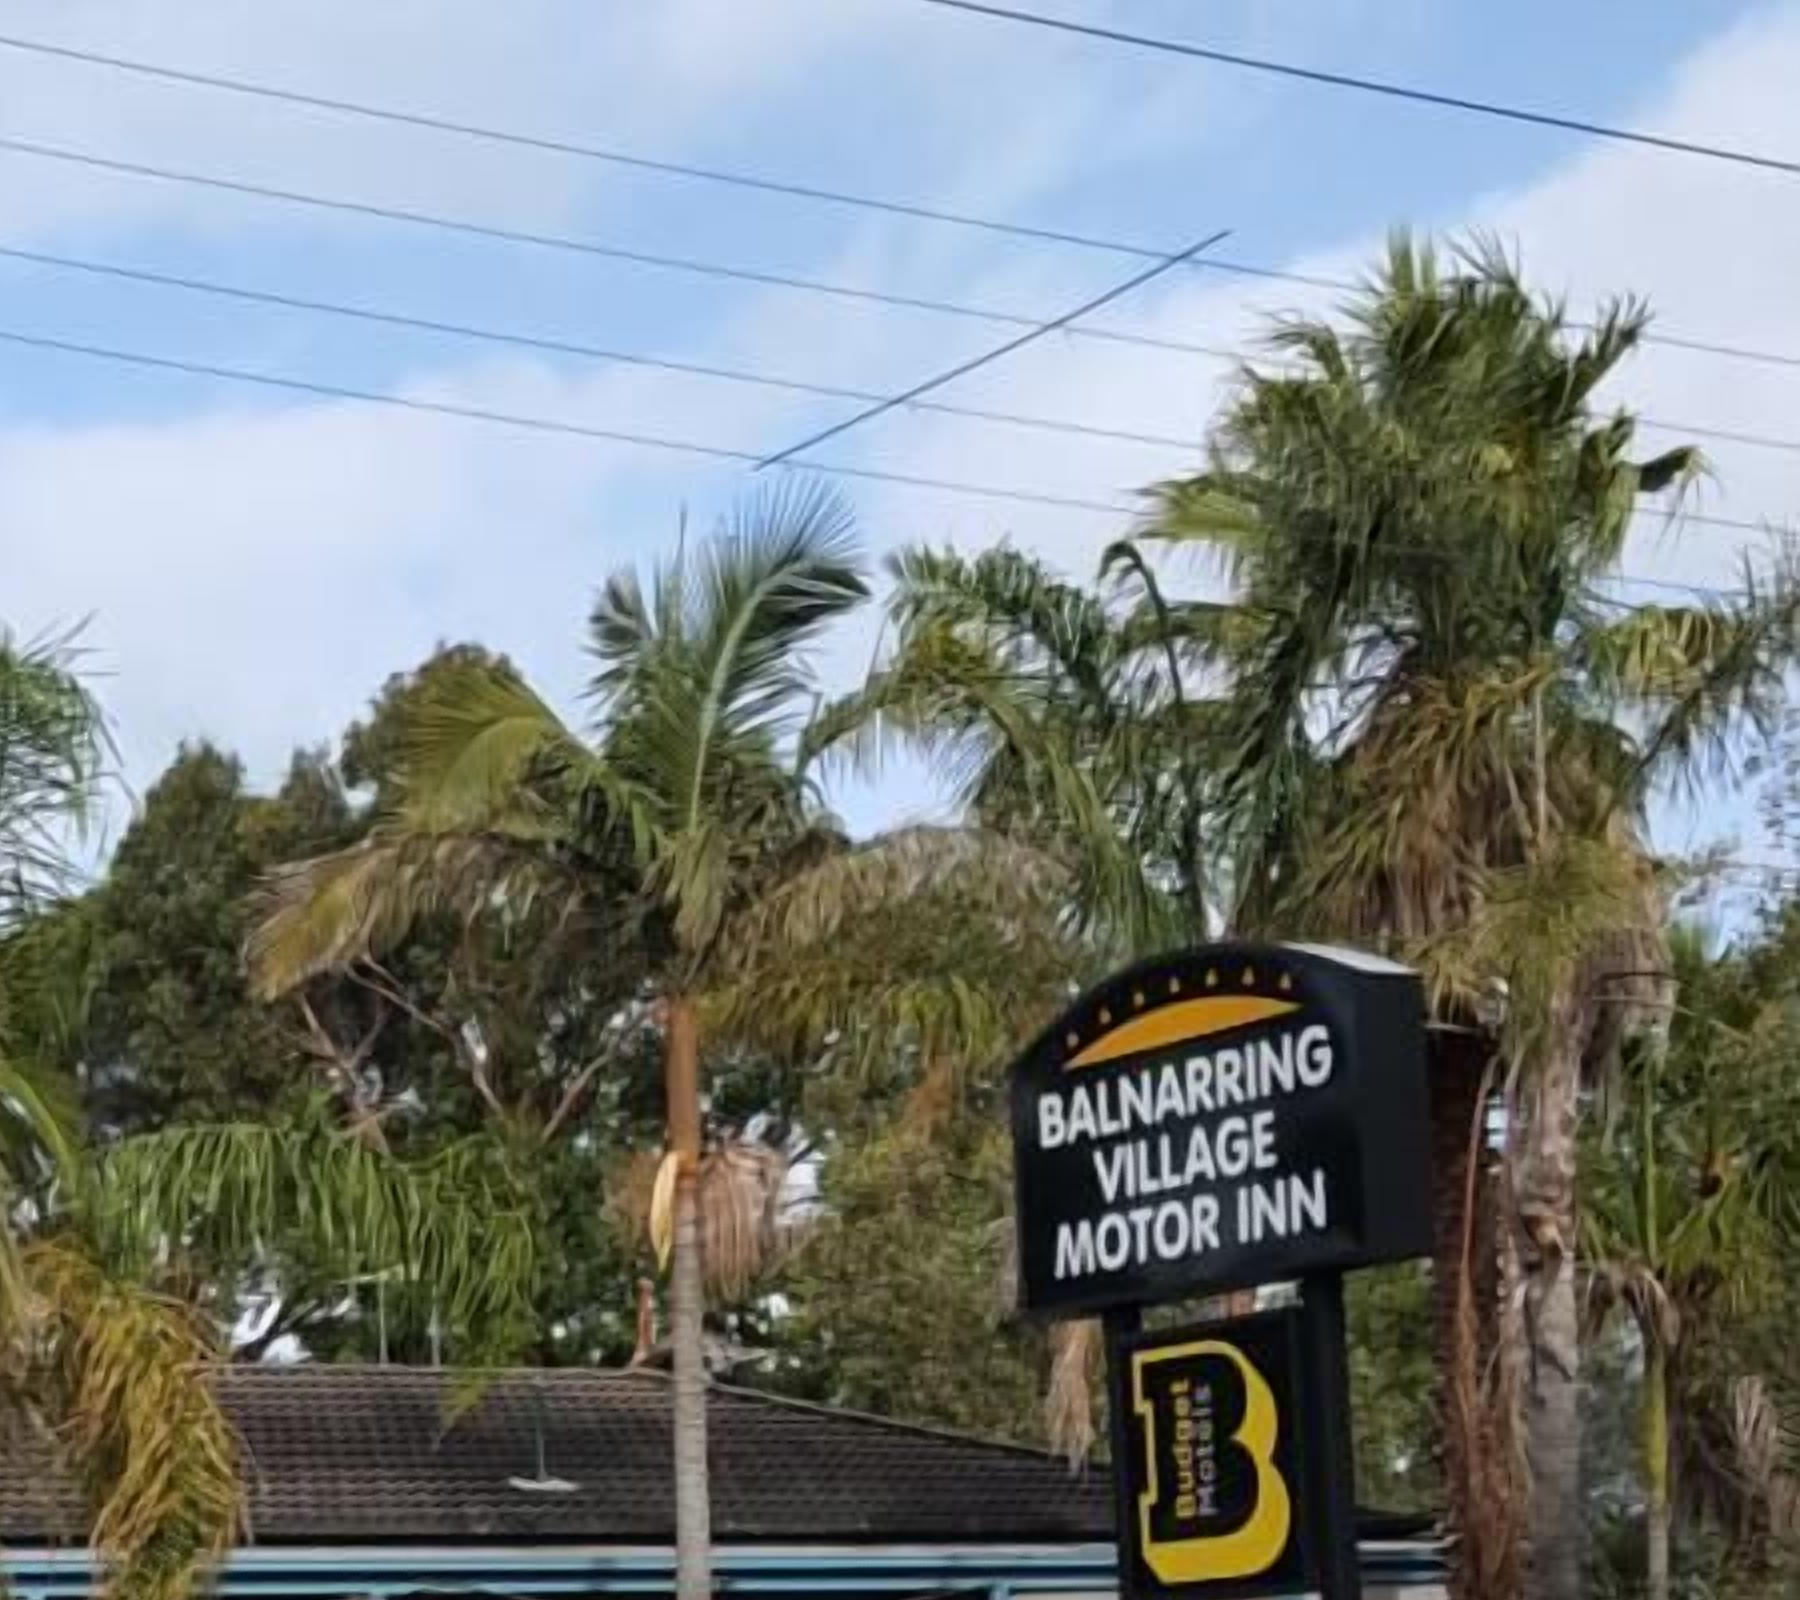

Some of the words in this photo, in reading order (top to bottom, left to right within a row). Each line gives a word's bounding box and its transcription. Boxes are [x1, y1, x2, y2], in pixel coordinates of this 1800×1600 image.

[1038, 1025, 1333, 1148] BALNARRING
[1093, 1111, 1278, 1202] VILLAGE
[1055, 1195, 1220, 1279] MOTOR
[1237, 1169, 1327, 1245] INN
[1170, 1377, 1196, 1518] Budget
